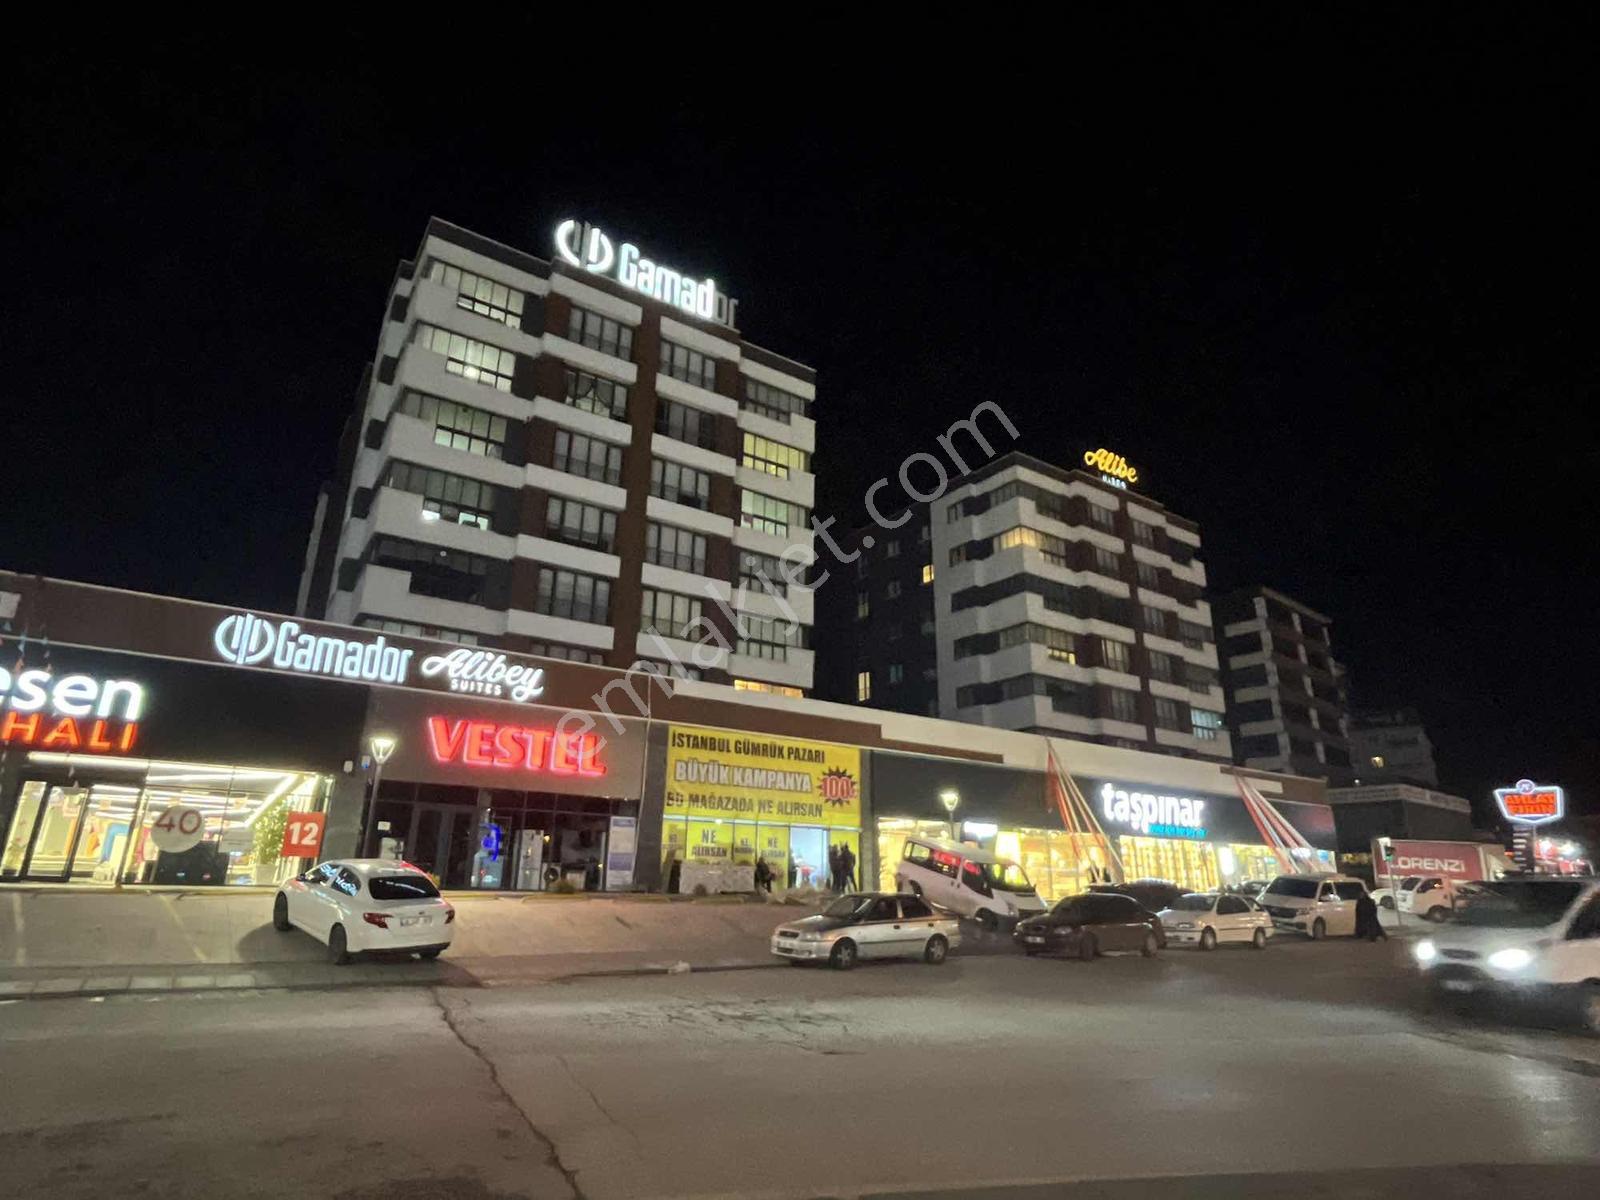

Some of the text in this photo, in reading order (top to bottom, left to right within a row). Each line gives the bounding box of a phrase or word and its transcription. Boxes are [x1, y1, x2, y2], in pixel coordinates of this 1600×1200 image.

[618, 243, 739, 328] Gamador
[272, 621, 544, 702] Gamador Alibey
[0, 667, 143, 721] sen
[451, 678, 502, 696] SUITES
[2, 711, 138, 752] HALI
[428, 717, 607, 776] VESTEL
[672, 731, 826, 764] İSTANBUL GÜMRÜK PAZARI
[674, 758, 813, 793] BÜYÜK KAMPANYA
[155, 809, 202, 835] 40
[688, 793, 753, 813] MAĞAZADA
[757, 799, 775, 815] NE
[776, 801, 824, 818] ALIRSAN
[1101, 783, 1205, 834] taşpınar
[289, 822, 319, 846] 12
[702, 829, 716, 844] NE
